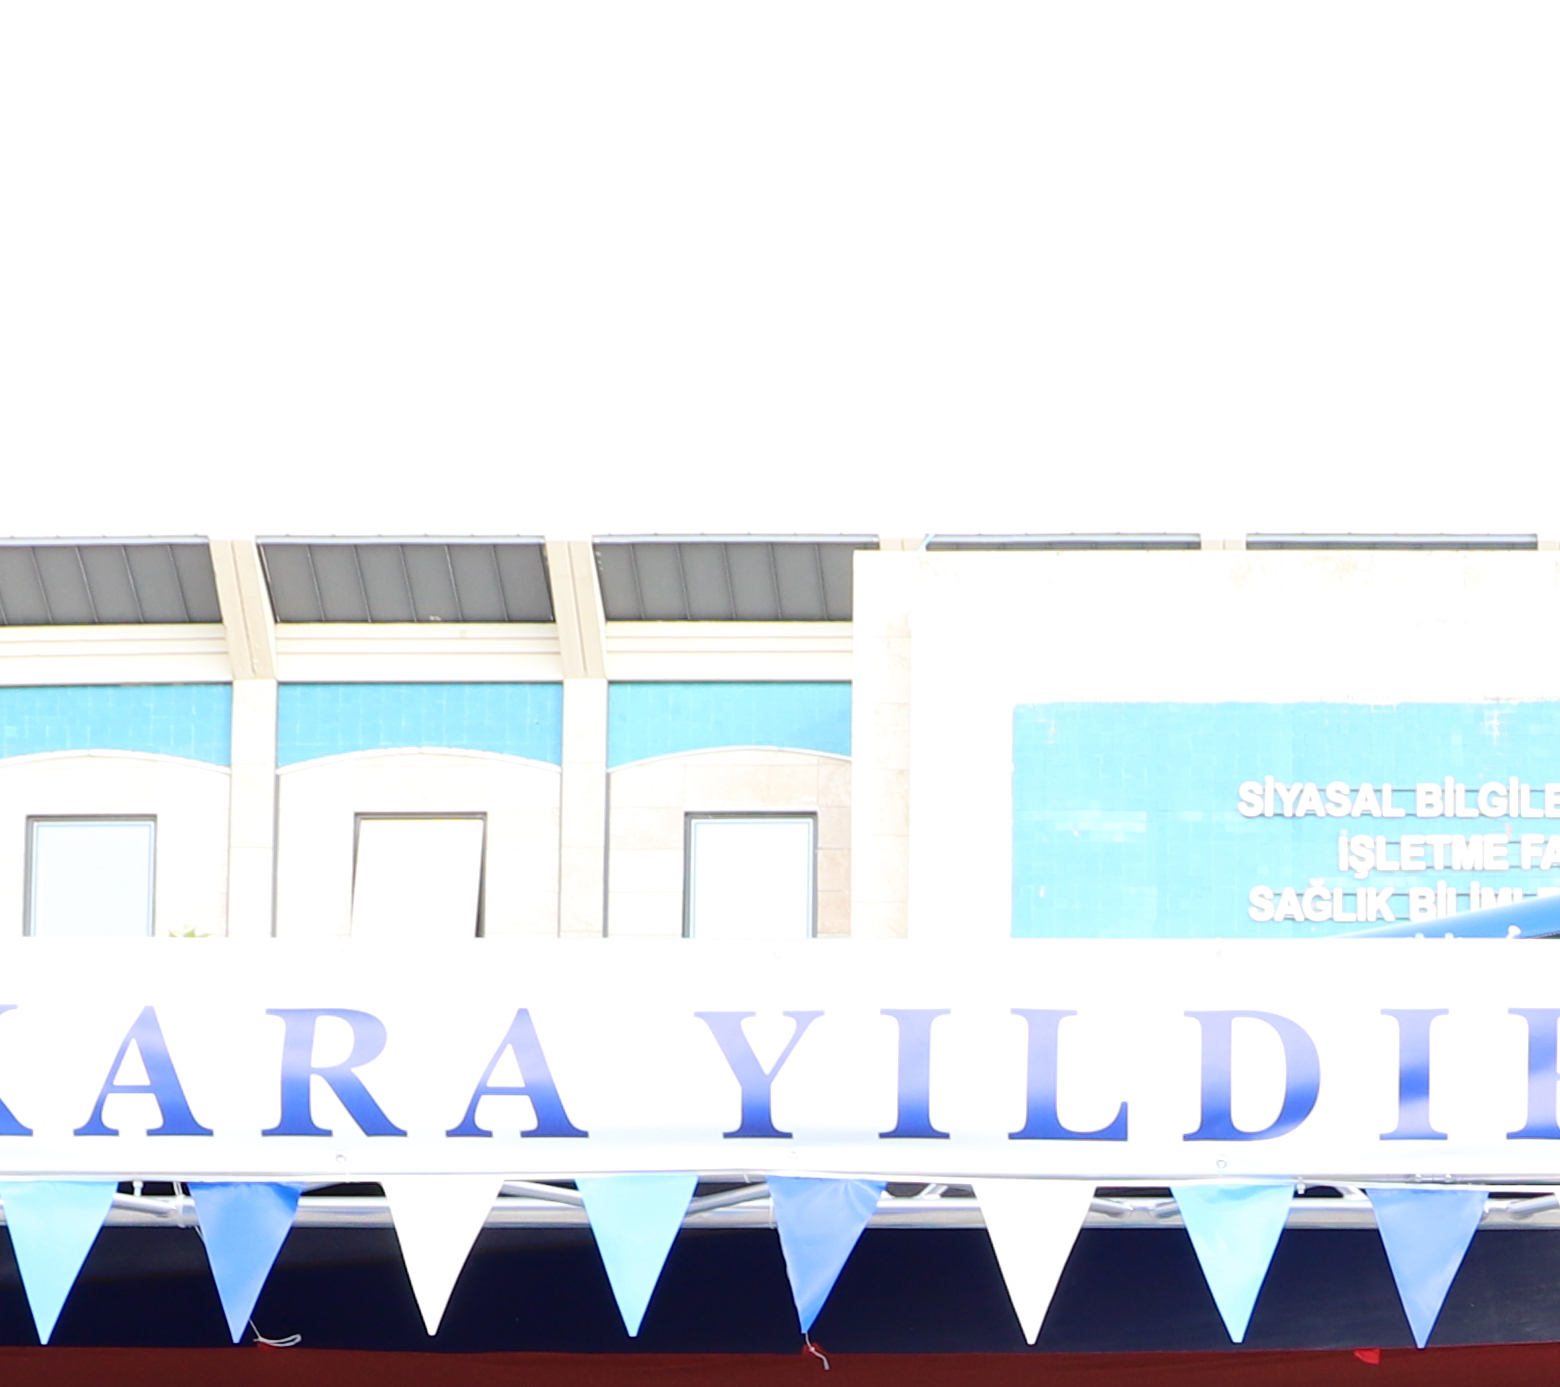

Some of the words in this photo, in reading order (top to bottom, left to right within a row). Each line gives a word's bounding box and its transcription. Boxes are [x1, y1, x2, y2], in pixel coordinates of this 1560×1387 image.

[1238, 775, 1406, 819] SİYASAL
[1338, 829, 1510, 879] İŞLETME
[1247, 877, 1396, 922] SAĞLIK
